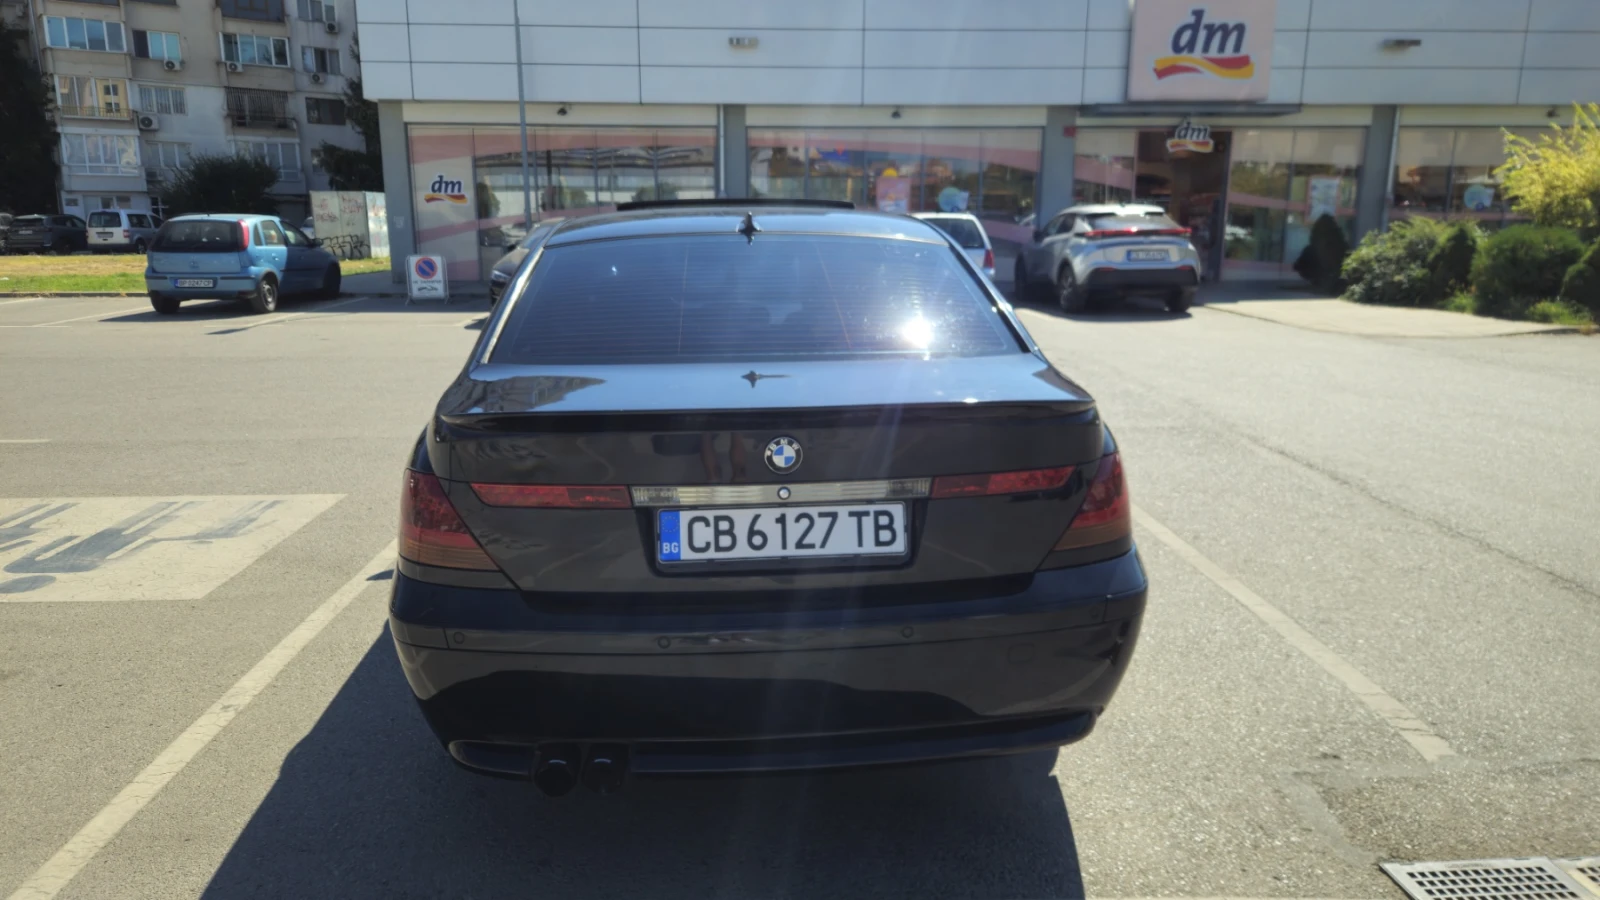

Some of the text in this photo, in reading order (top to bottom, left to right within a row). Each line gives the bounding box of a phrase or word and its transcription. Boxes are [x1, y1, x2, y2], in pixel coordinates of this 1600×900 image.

[1171, 8, 1246, 54] dm
[1176, 121, 1208, 140] dm
[431, 174, 462, 193] dm
[769, 438, 801, 450] BMW
[687, 509, 898, 554] CB 6127 TB
[662, 542, 680, 554] BG
